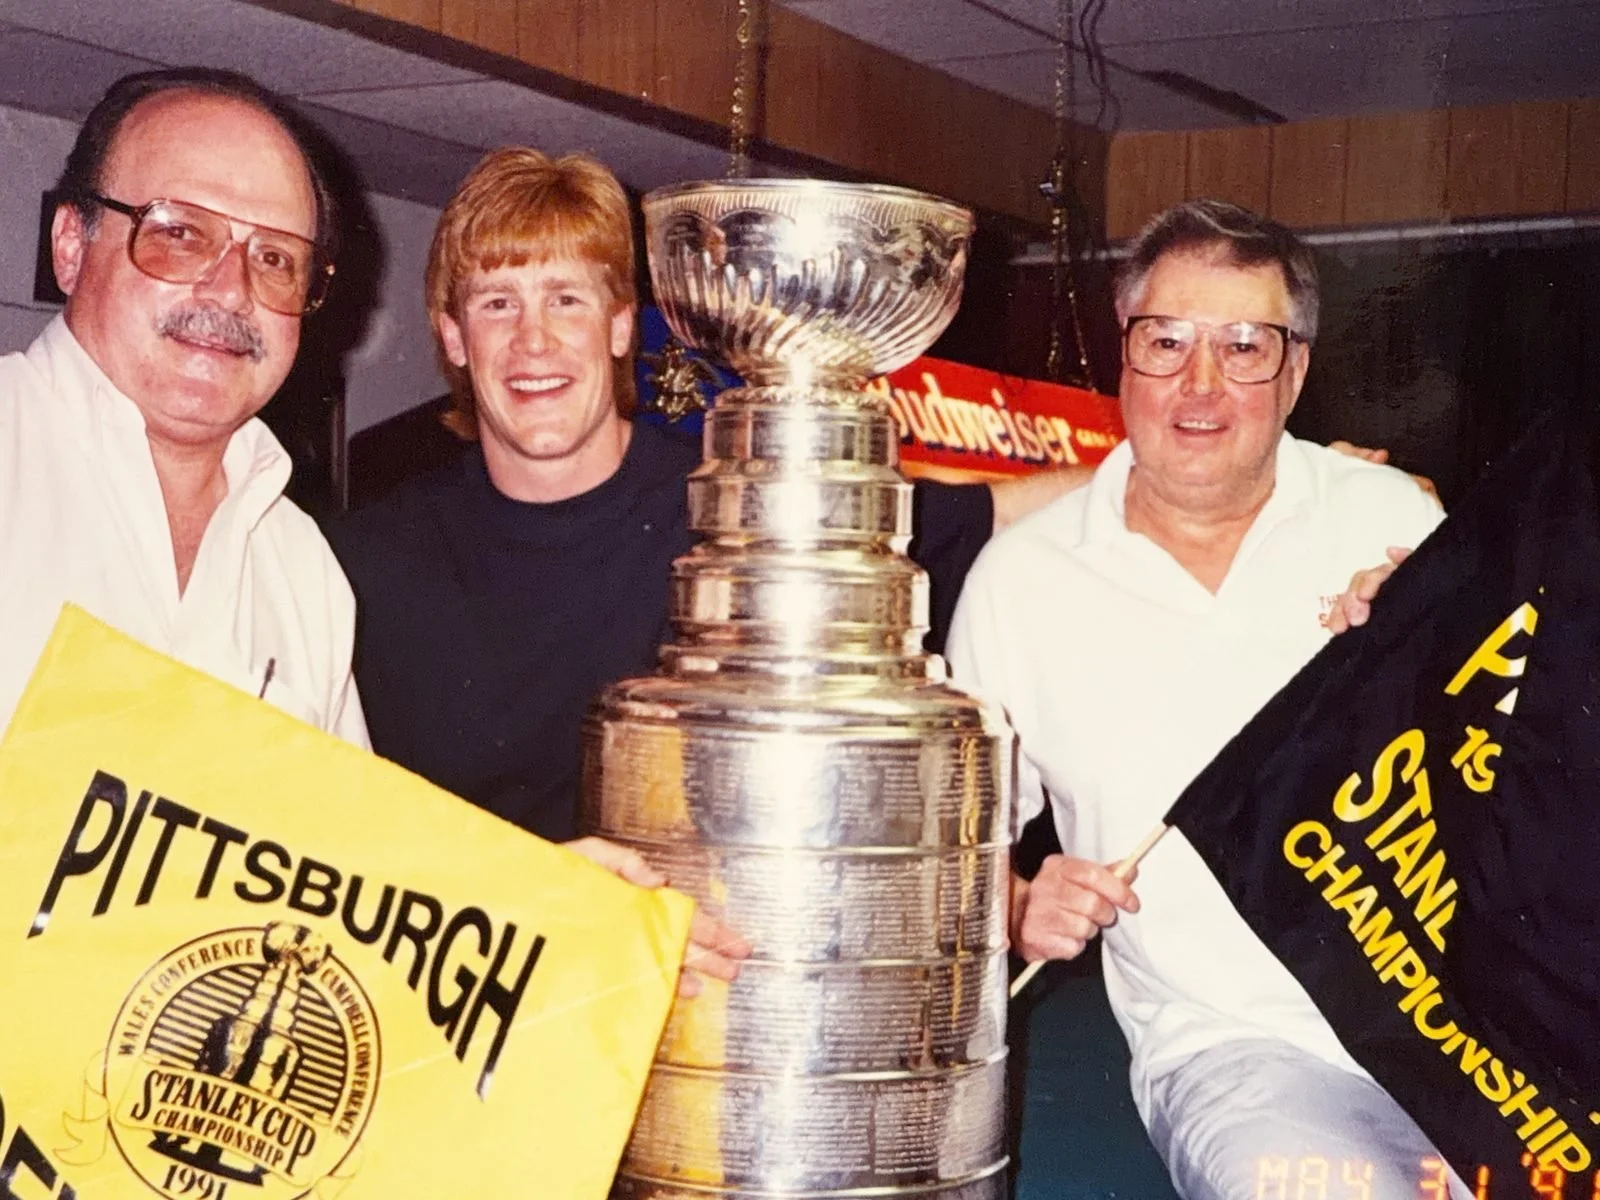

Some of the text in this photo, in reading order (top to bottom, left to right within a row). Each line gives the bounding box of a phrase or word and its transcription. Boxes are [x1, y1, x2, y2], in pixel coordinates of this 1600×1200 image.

[27, 769, 546, 1102] PITTSBURGH
[118, 938, 255, 1057] WALES CONFERENCE
[320, 968, 370, 1137] CAMPBELL CONFERENCE
[1283, 820, 1592, 1173] CHAMPIONSHIP
[130, 1069, 317, 1176] STANLEY CUP
[153, 1108, 285, 1167] CHAMPIONSHIP
[161, 1164, 229, 1200] 1991
